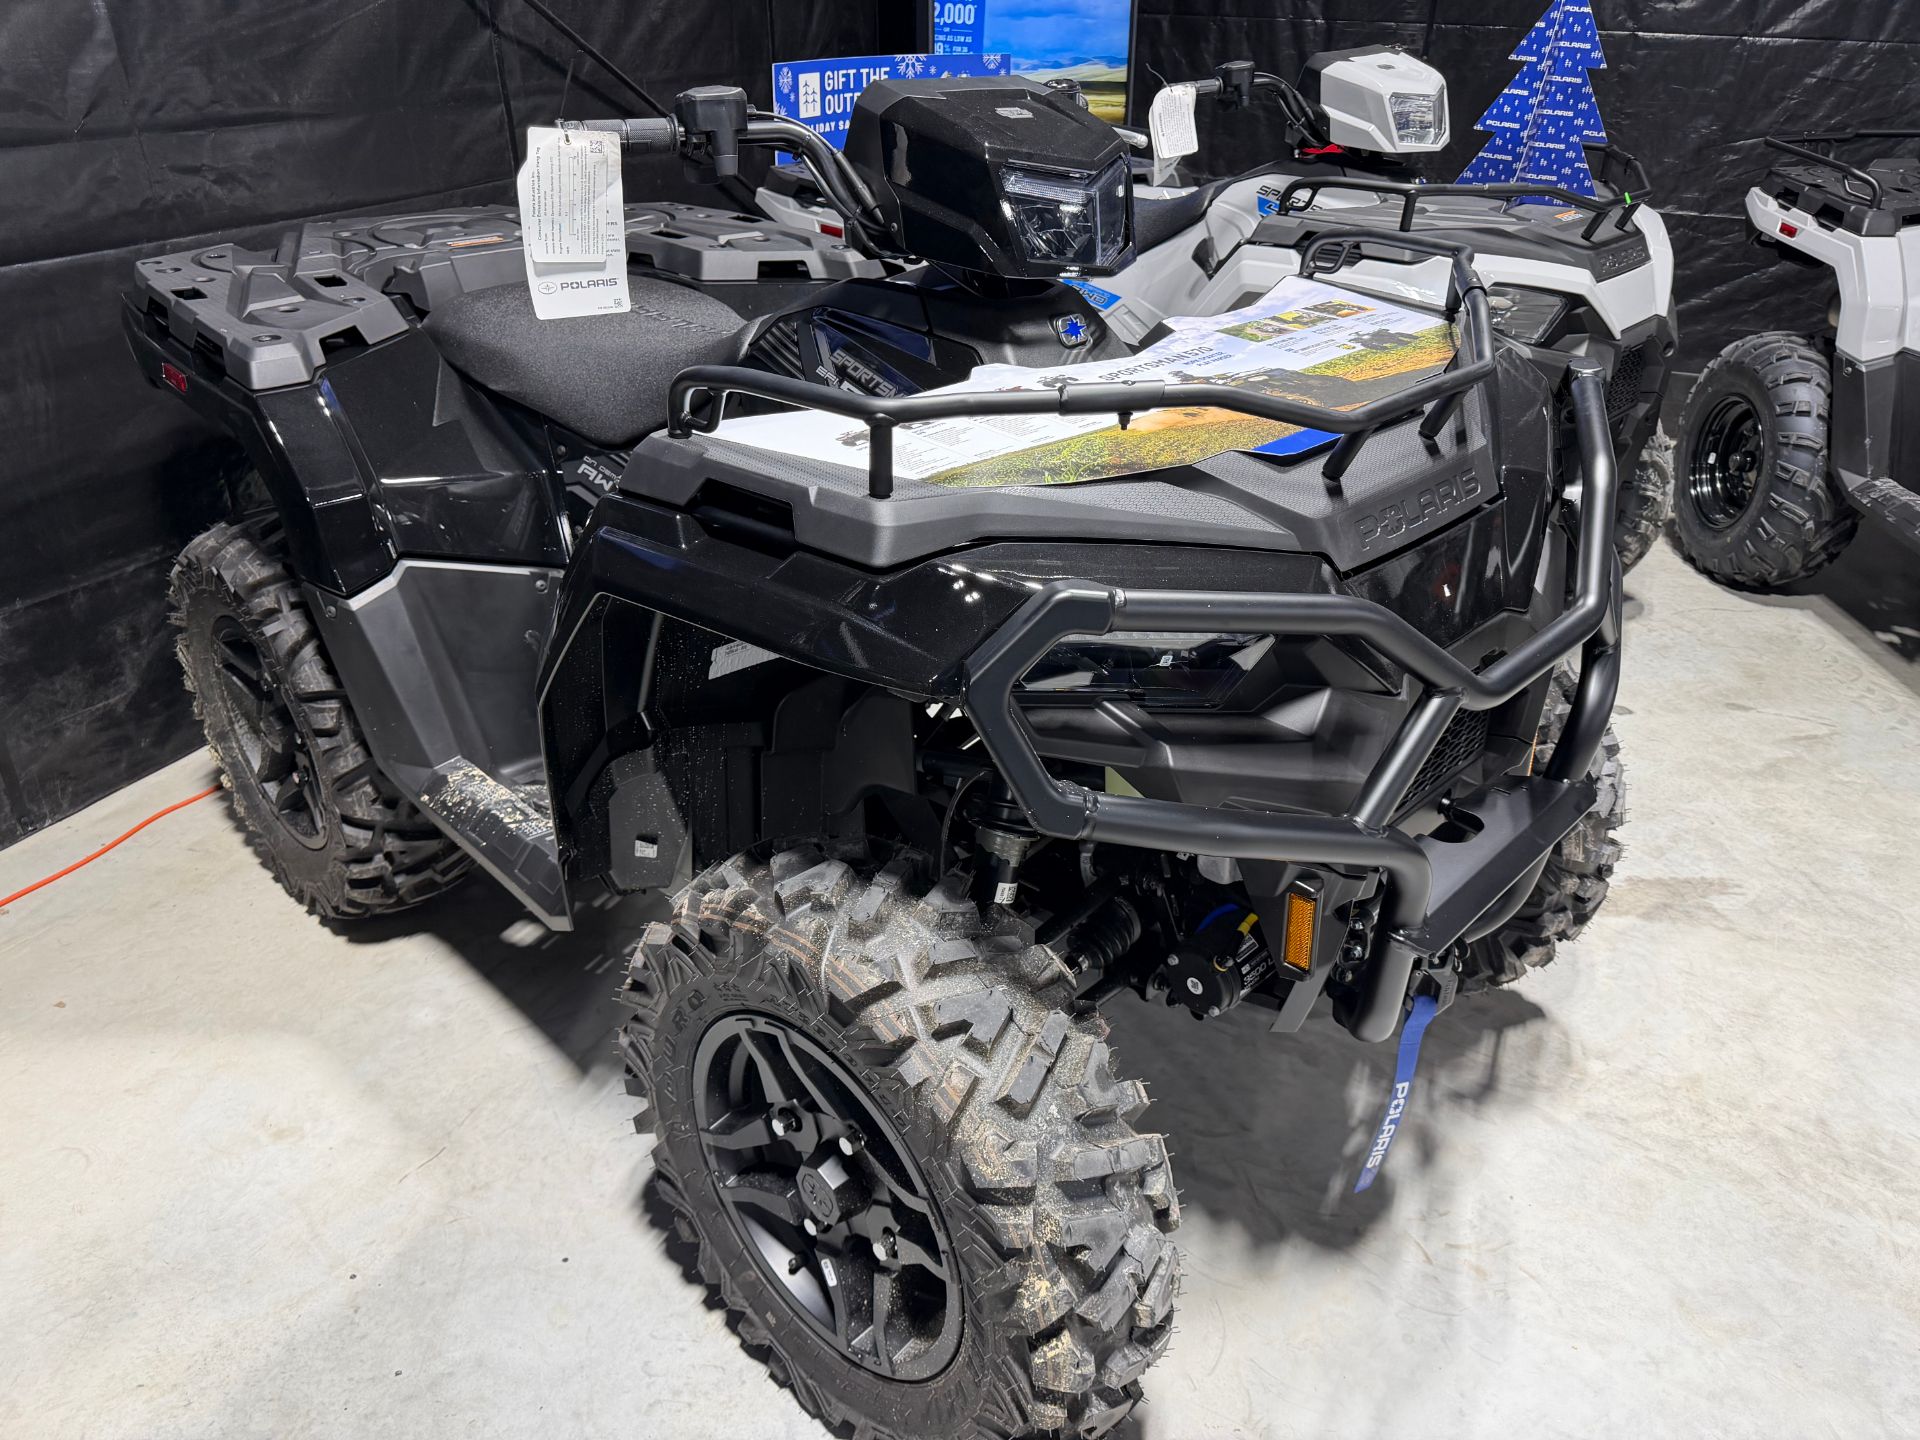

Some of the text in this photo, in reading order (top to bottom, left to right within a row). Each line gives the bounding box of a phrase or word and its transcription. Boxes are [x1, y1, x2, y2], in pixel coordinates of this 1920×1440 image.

[824, 69, 857, 91] GIFT
[1486, 119, 1520, 129] POLARIS
[1479, 151, 1512, 161] POLARIS
[560, 277, 618, 291] POLARIS
[1098, 350, 1190, 381] SPORTSMAN
[1354, 467, 1481, 552] POLARIS
[1366, 1081, 1410, 1169] POLARIS
